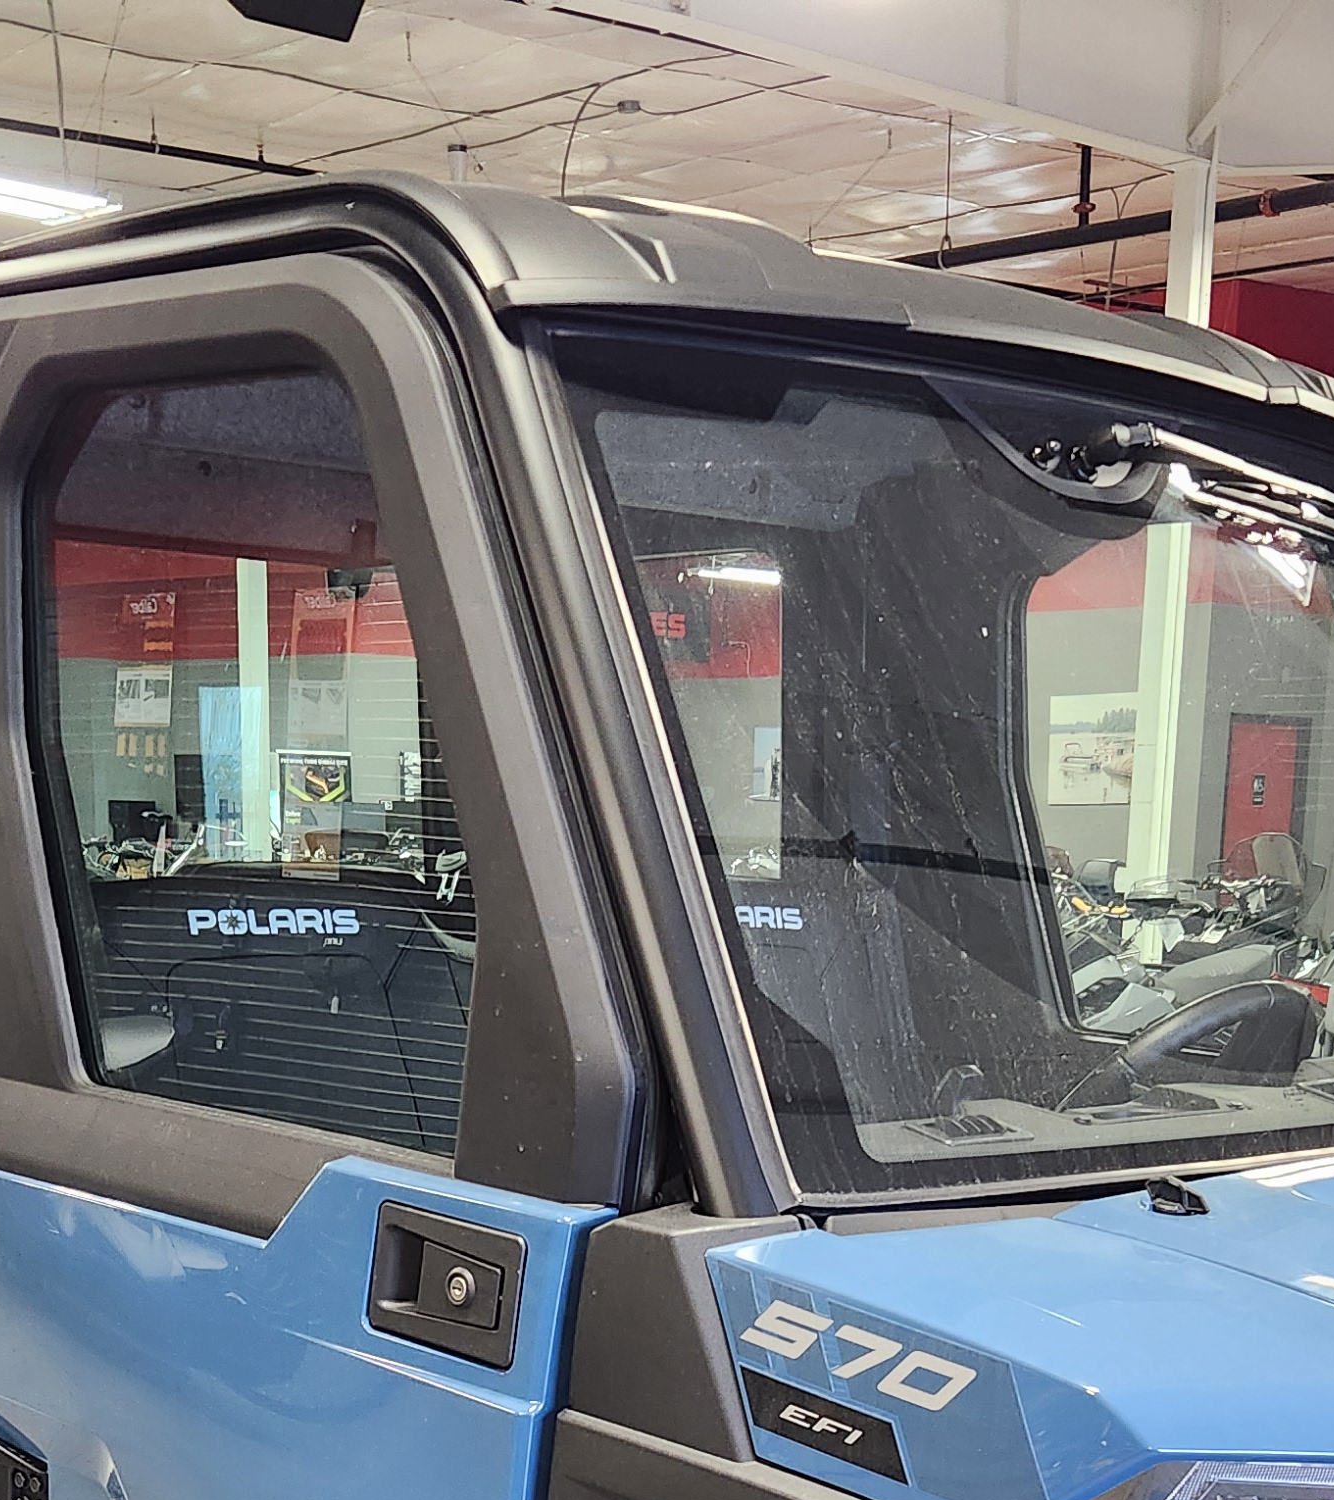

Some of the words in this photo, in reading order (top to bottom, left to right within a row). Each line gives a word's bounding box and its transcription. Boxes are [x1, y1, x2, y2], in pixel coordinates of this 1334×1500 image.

[187, 908, 359, 936] POLARIS
[739, 1299, 977, 1412] 570
[779, 1403, 863, 1446] EFI
